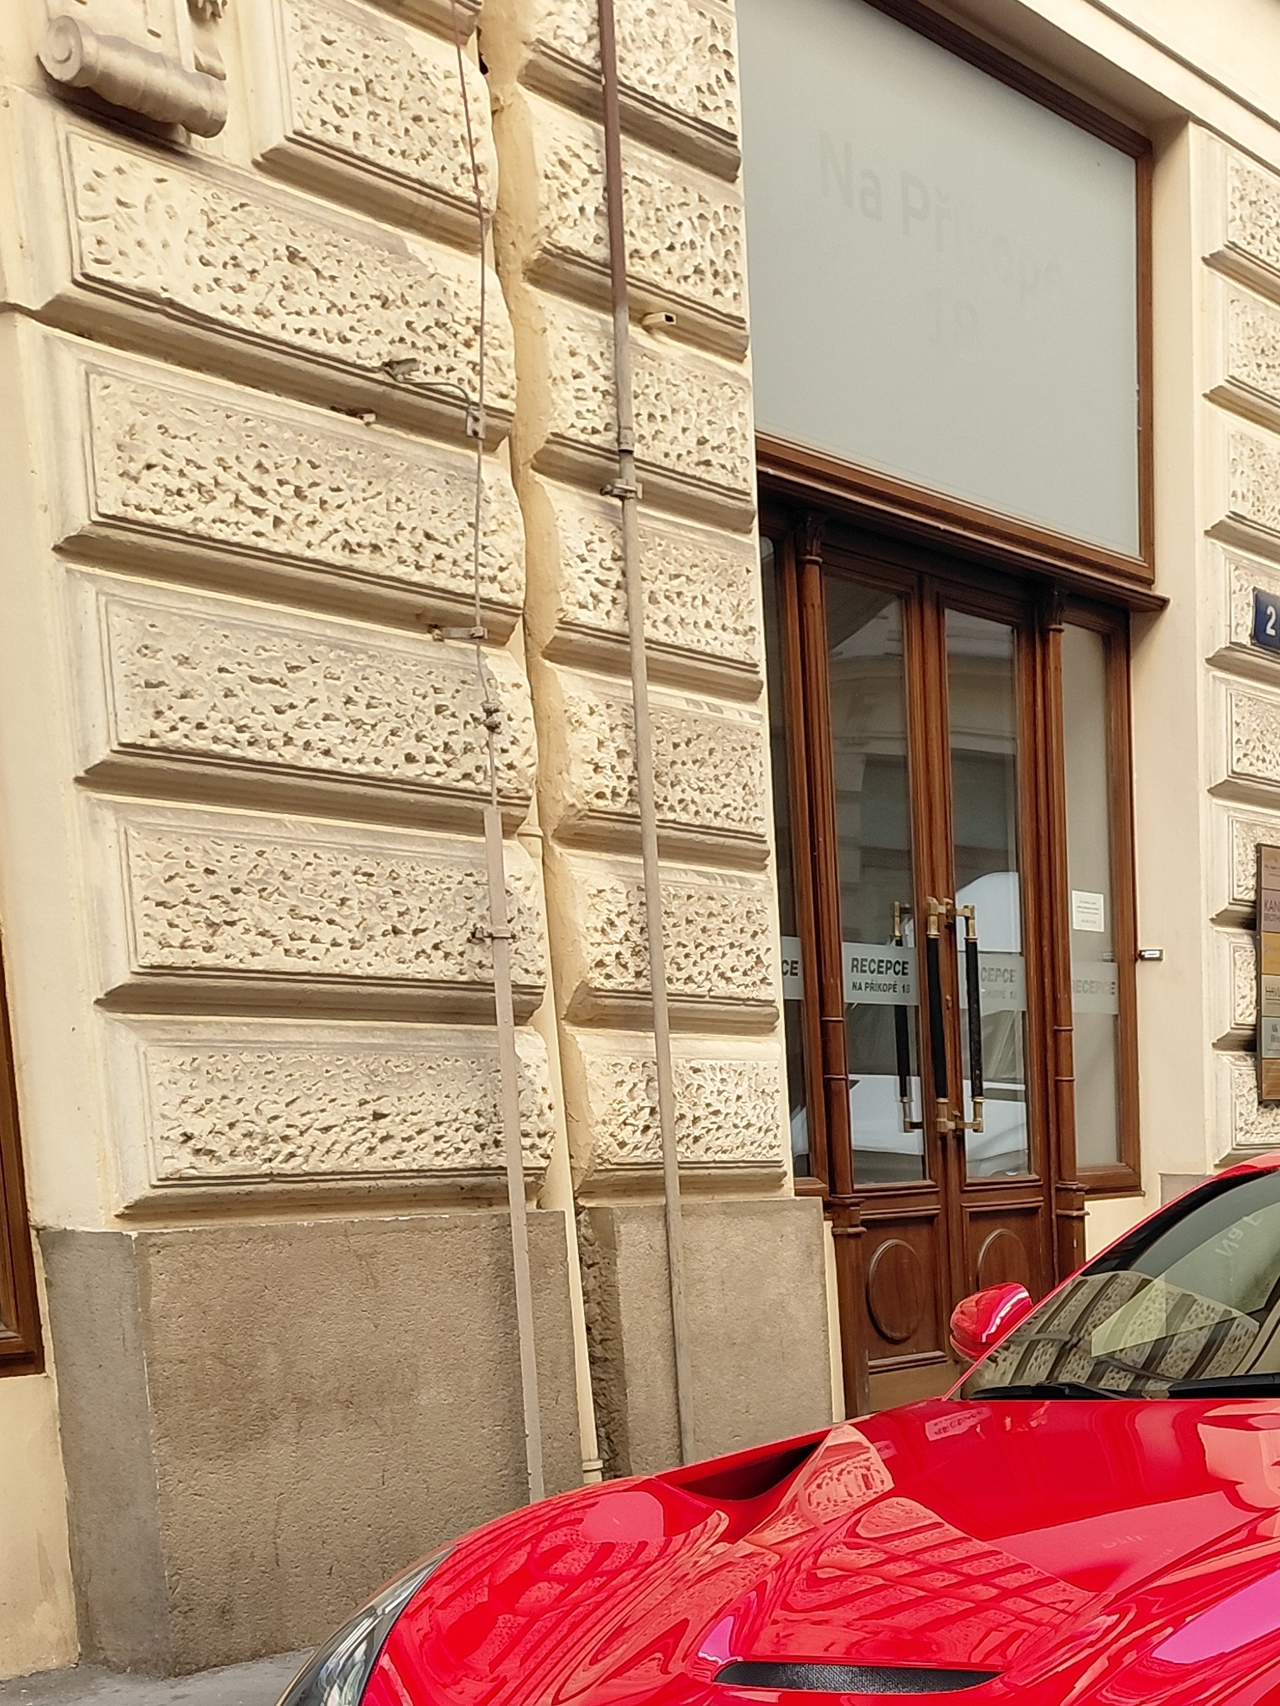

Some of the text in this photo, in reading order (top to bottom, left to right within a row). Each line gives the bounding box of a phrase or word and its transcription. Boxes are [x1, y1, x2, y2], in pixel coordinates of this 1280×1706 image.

[1265, 605, 1277, 637] 2
[850, 957, 910, 976] RECEPCE
[980, 966, 1016, 983] CEPCE
[852, 981, 863, 991] NA
